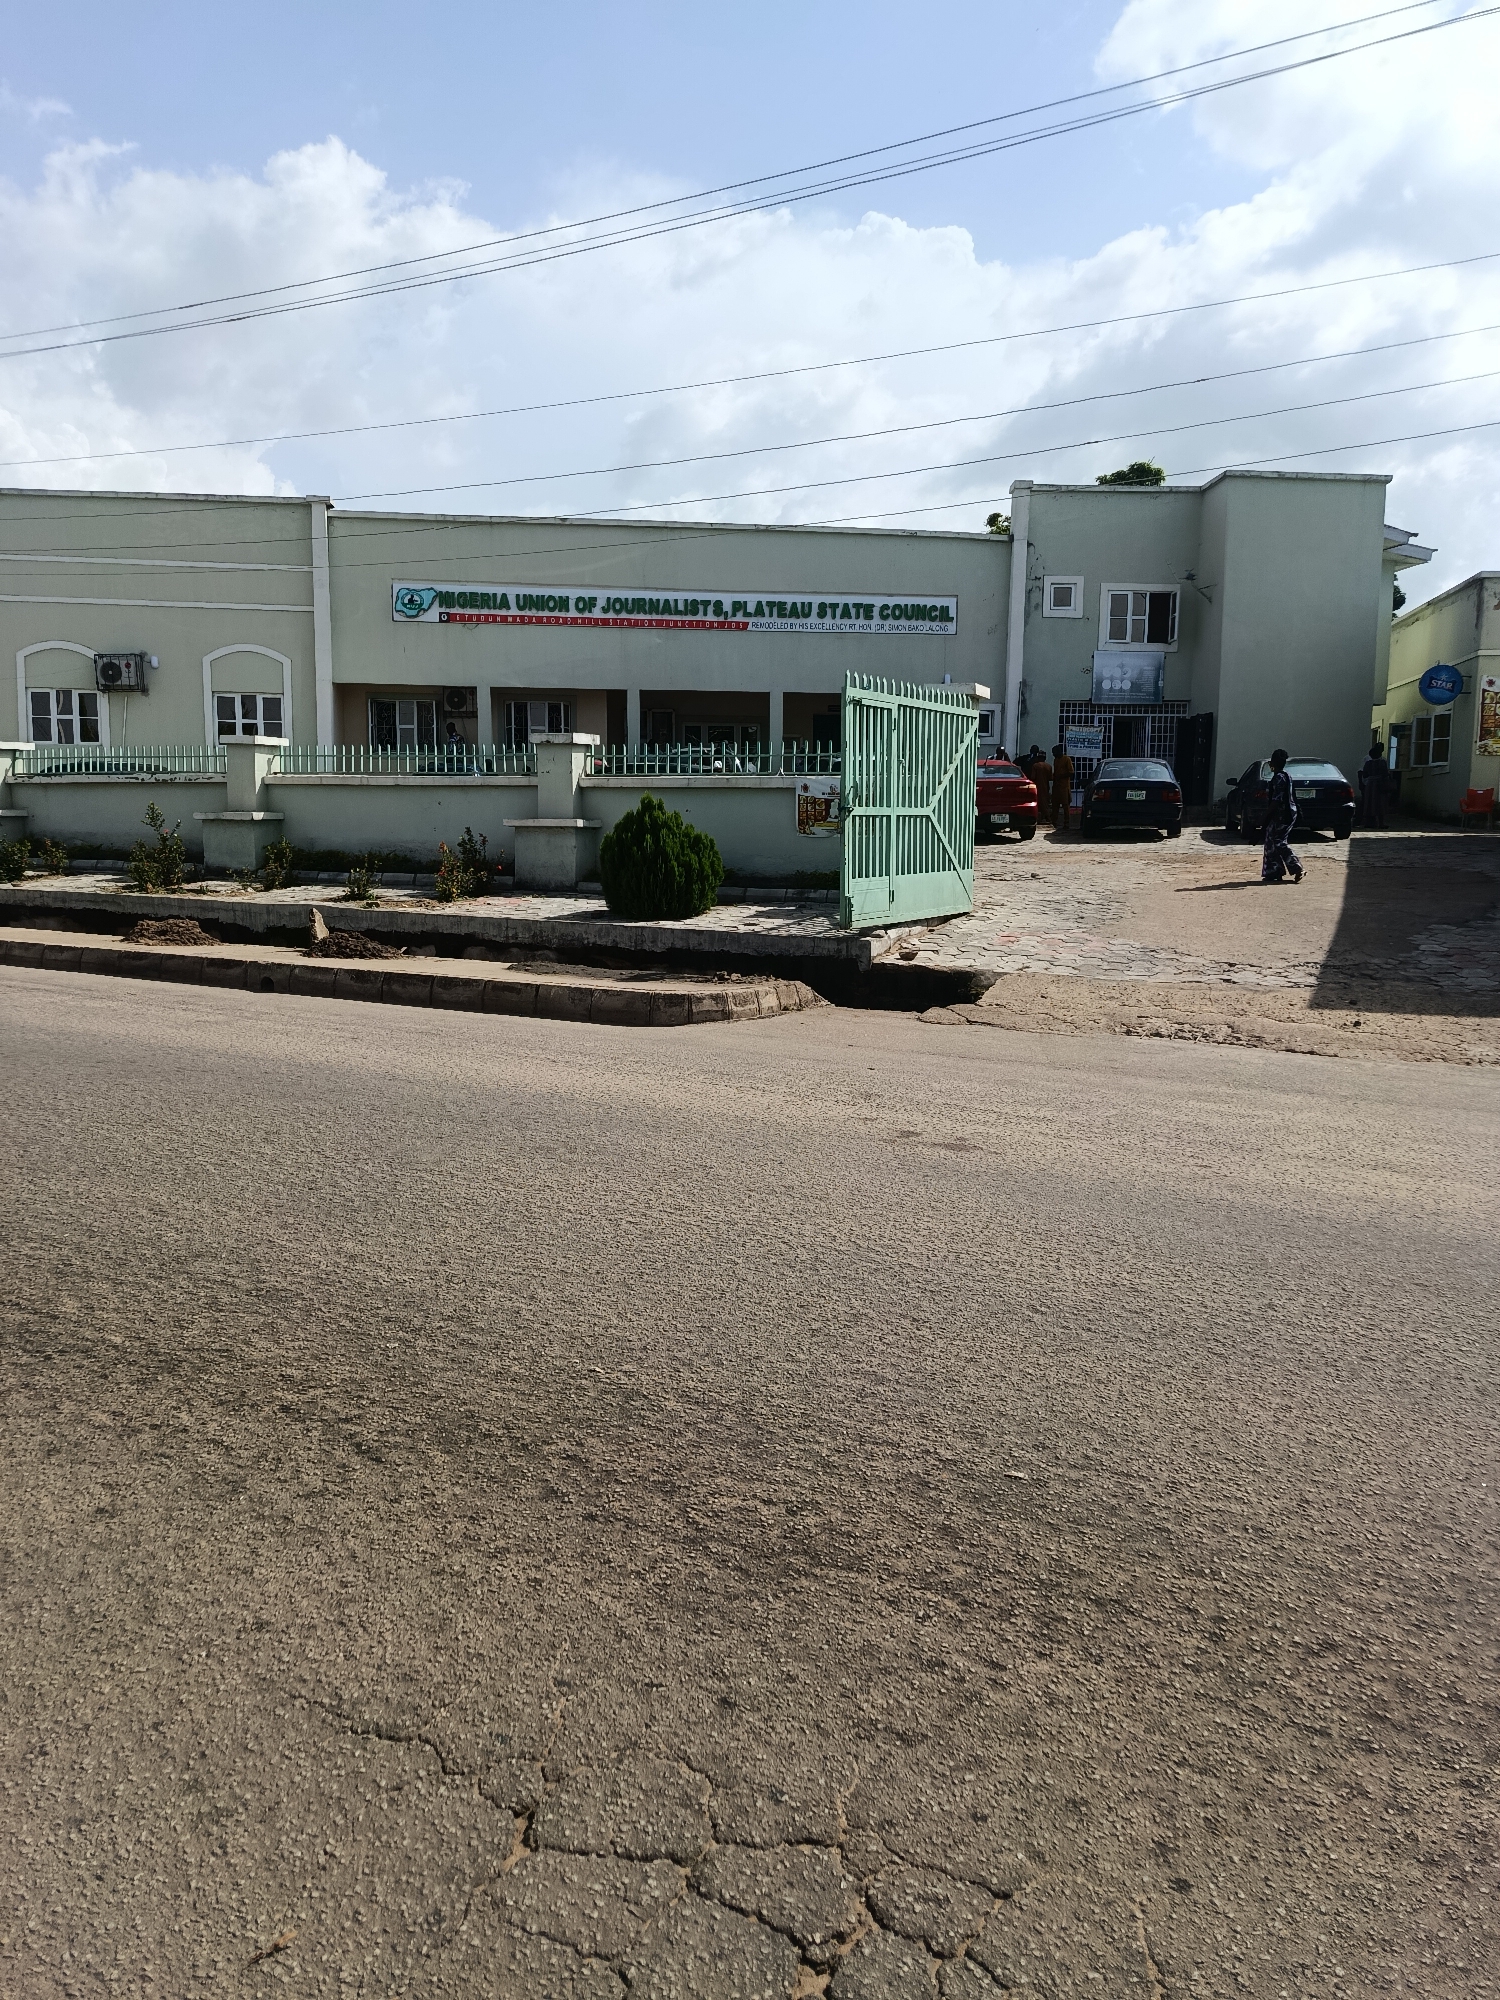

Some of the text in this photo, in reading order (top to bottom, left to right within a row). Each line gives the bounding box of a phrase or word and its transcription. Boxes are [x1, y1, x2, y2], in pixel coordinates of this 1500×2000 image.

[438, 591, 955, 622] NIGERIA UNION OF JOURNALISTS, PLATEAU STATE COUNCIL
[609, 619, 657, 628] STATION
[751, 622, 788, 630] REMODELED
[789, 622, 797, 630] BY
[809, 623, 848, 631] EXCELLENCY
[1430, 680, 1453, 690] STAR
